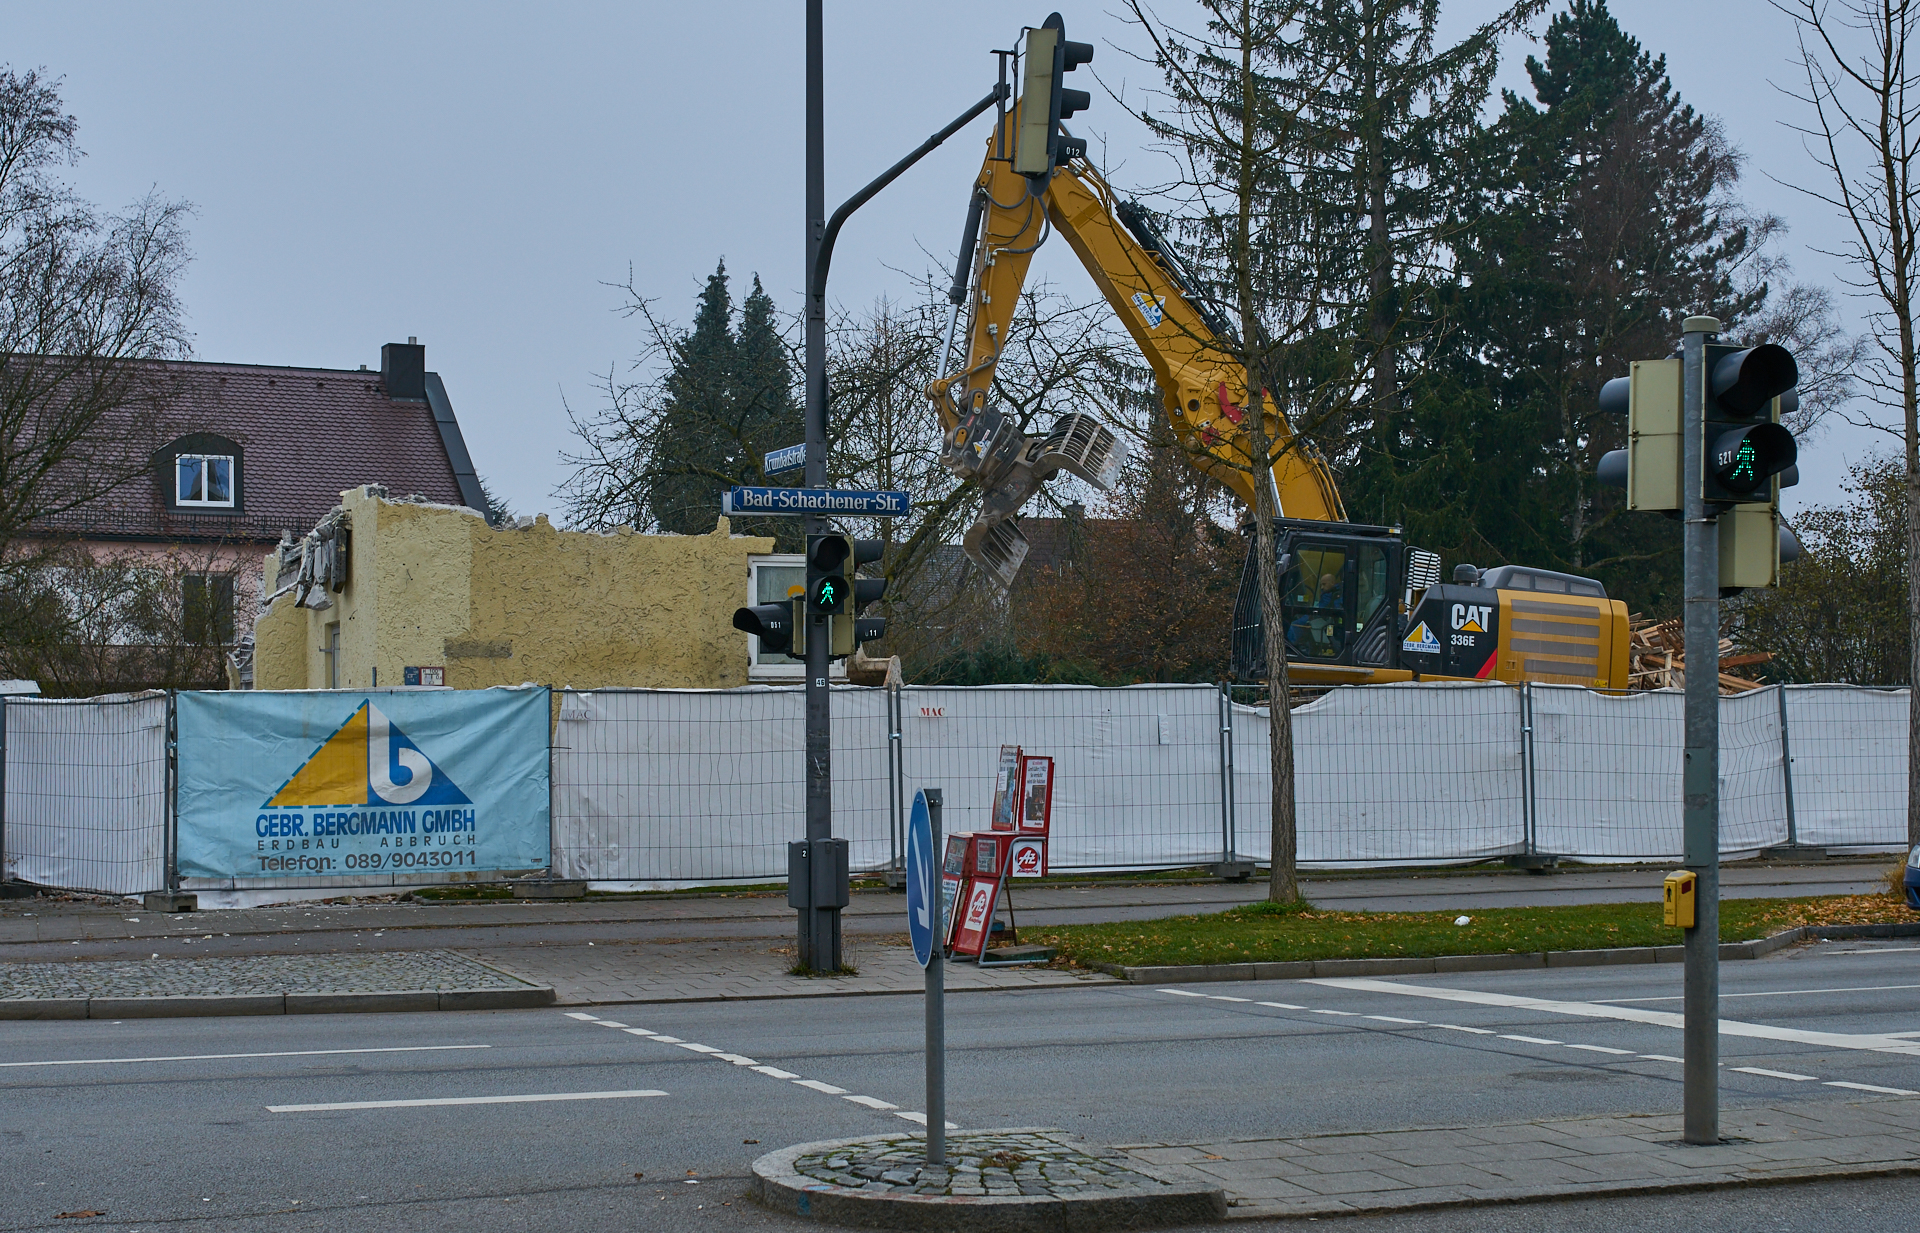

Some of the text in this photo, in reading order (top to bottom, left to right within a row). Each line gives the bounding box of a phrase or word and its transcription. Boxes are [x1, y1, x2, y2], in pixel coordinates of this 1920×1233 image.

[1066, 146, 1080, 157] 012
[1718, 450, 1732, 466] 521
[742, 489, 901, 511] Bad-Schachener-Str.
[1451, 603, 1493, 633] CAT
[1450, 634, 1475, 647] 336E
[566, 709, 592, 720] MAC
[920, 707, 946, 717] MAC
[255, 809, 476, 838] GEBR. BERGMANN GMBH
[257, 834, 476, 851] ERDBAU ABBRUCH
[257, 850, 476, 871] Telefon: 089/9043011
